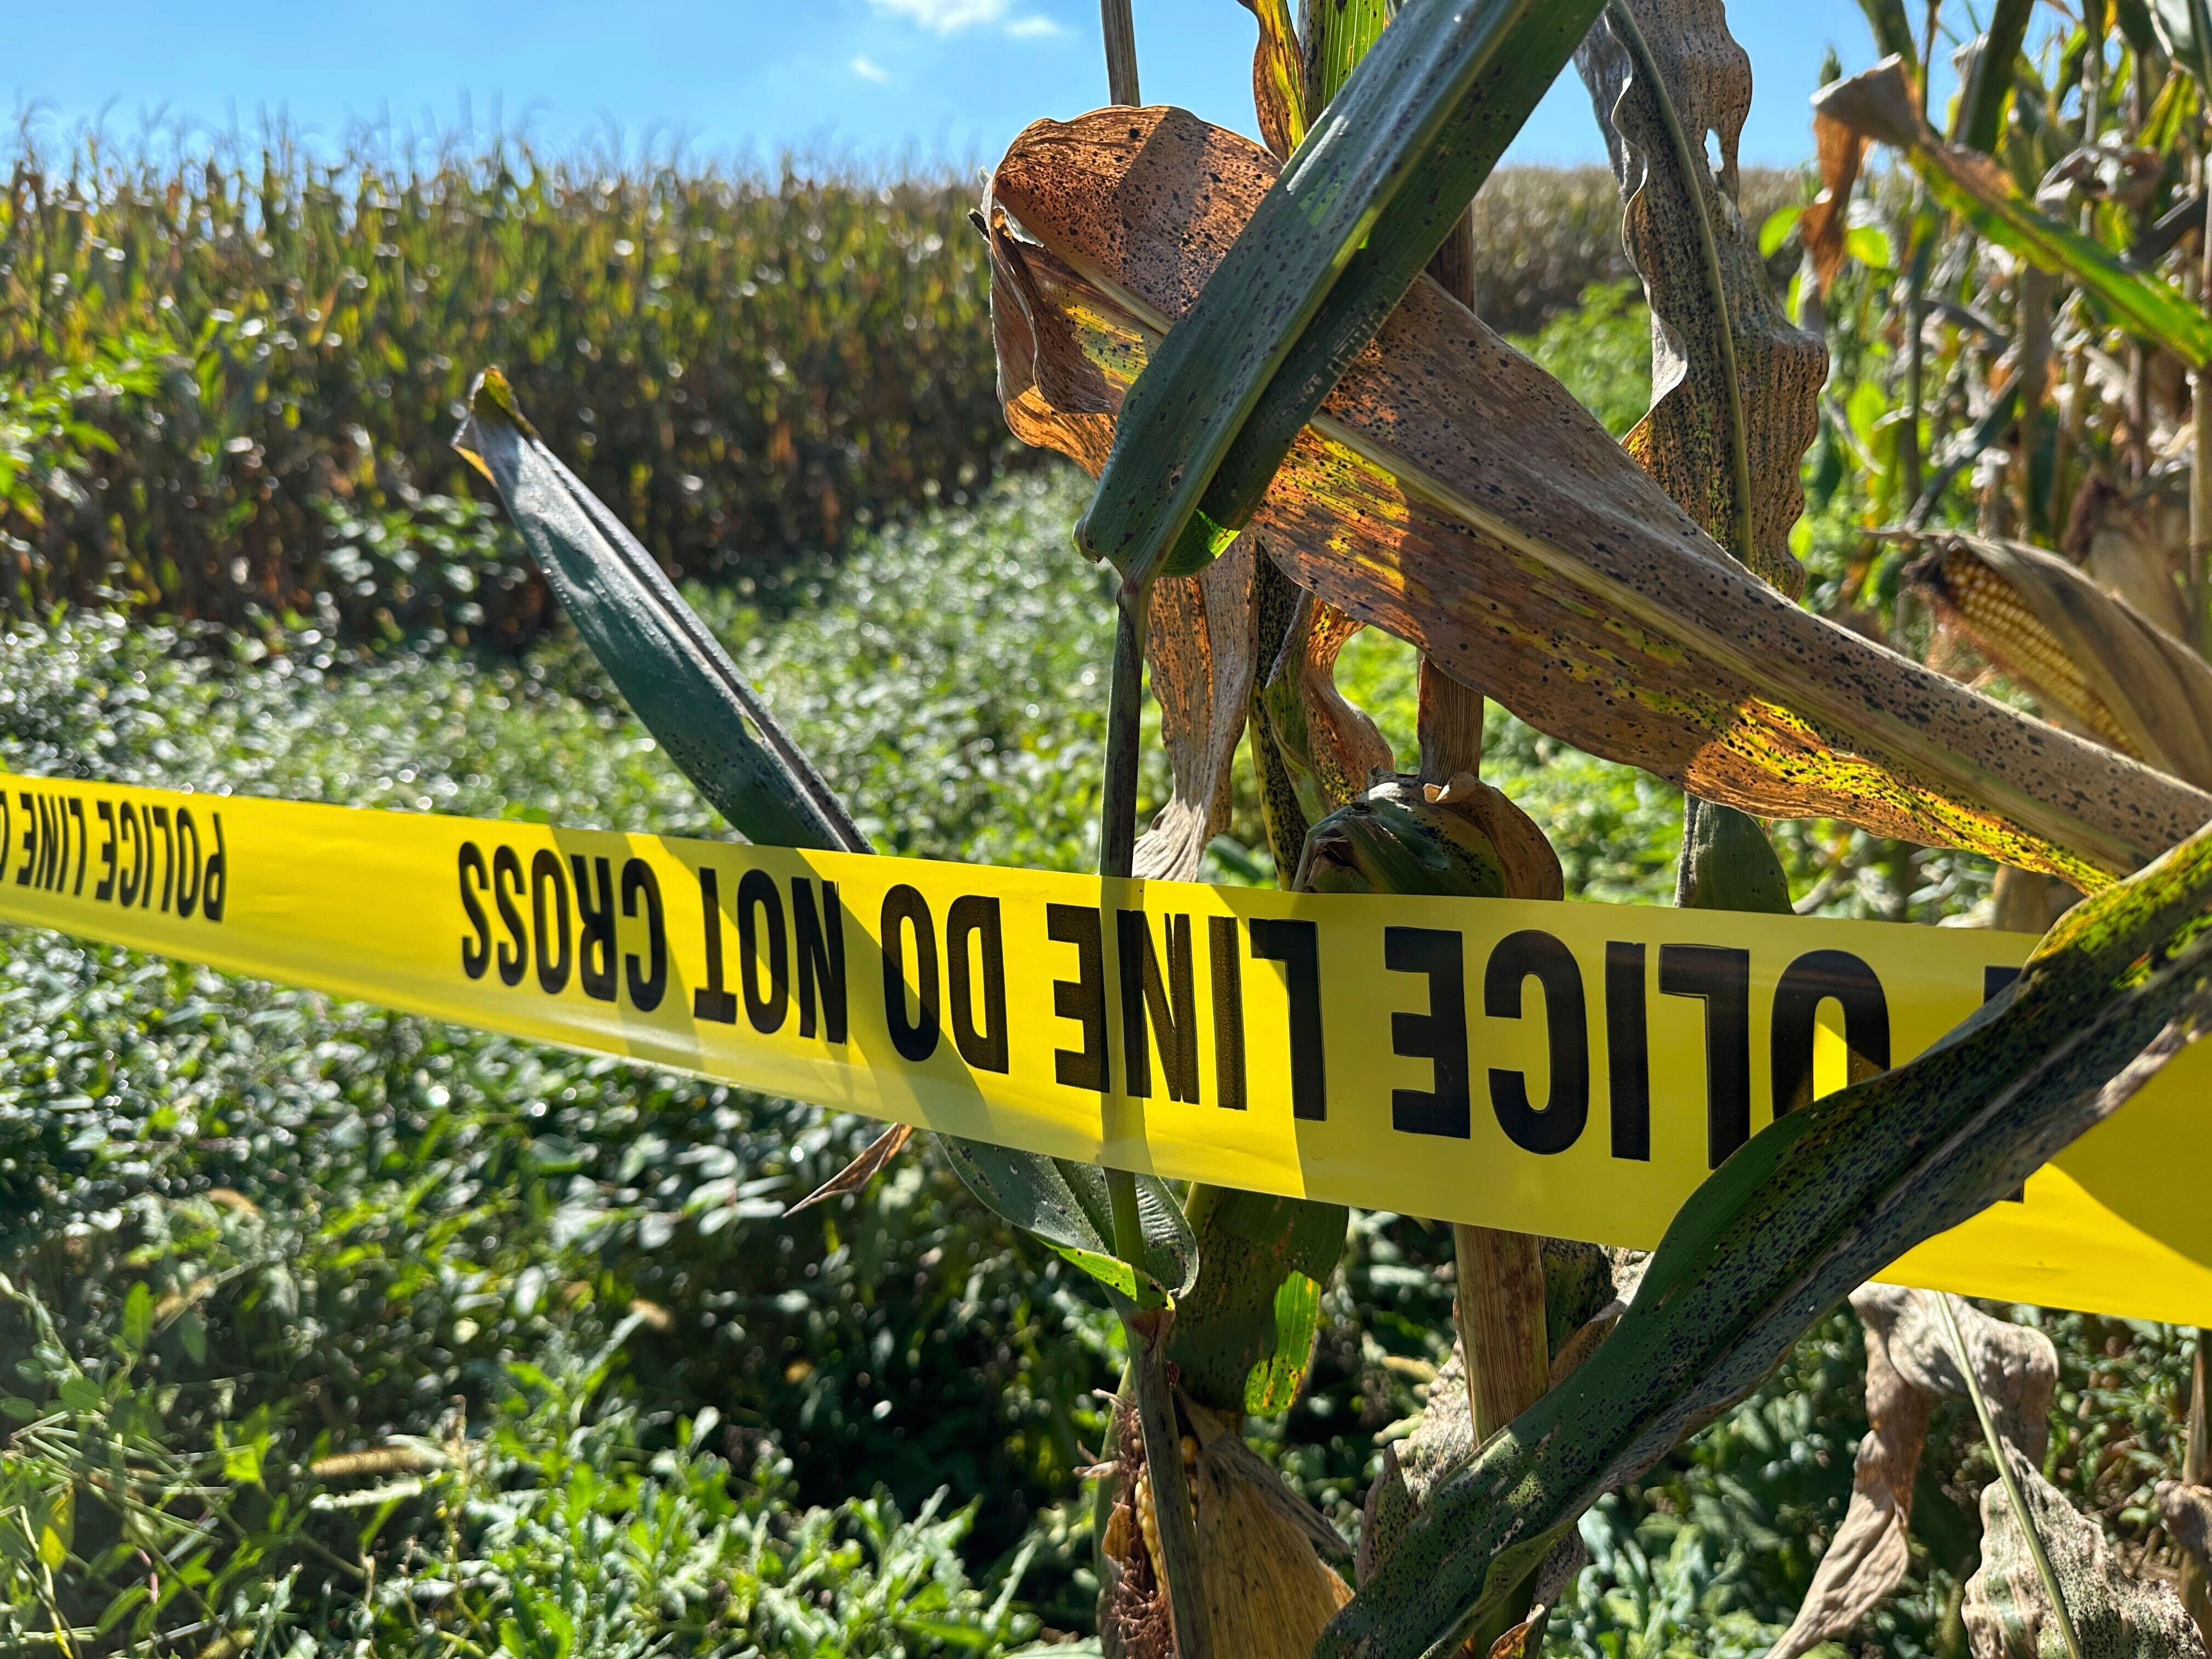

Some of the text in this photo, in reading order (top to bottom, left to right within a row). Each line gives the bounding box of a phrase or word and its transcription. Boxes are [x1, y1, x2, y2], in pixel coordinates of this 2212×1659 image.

[16, 792, 87, 895] LINE
[95, 800, 227, 922] POLICE
[458, 841, 2024, 1204] OLICE LINE DO NOT CROSS
